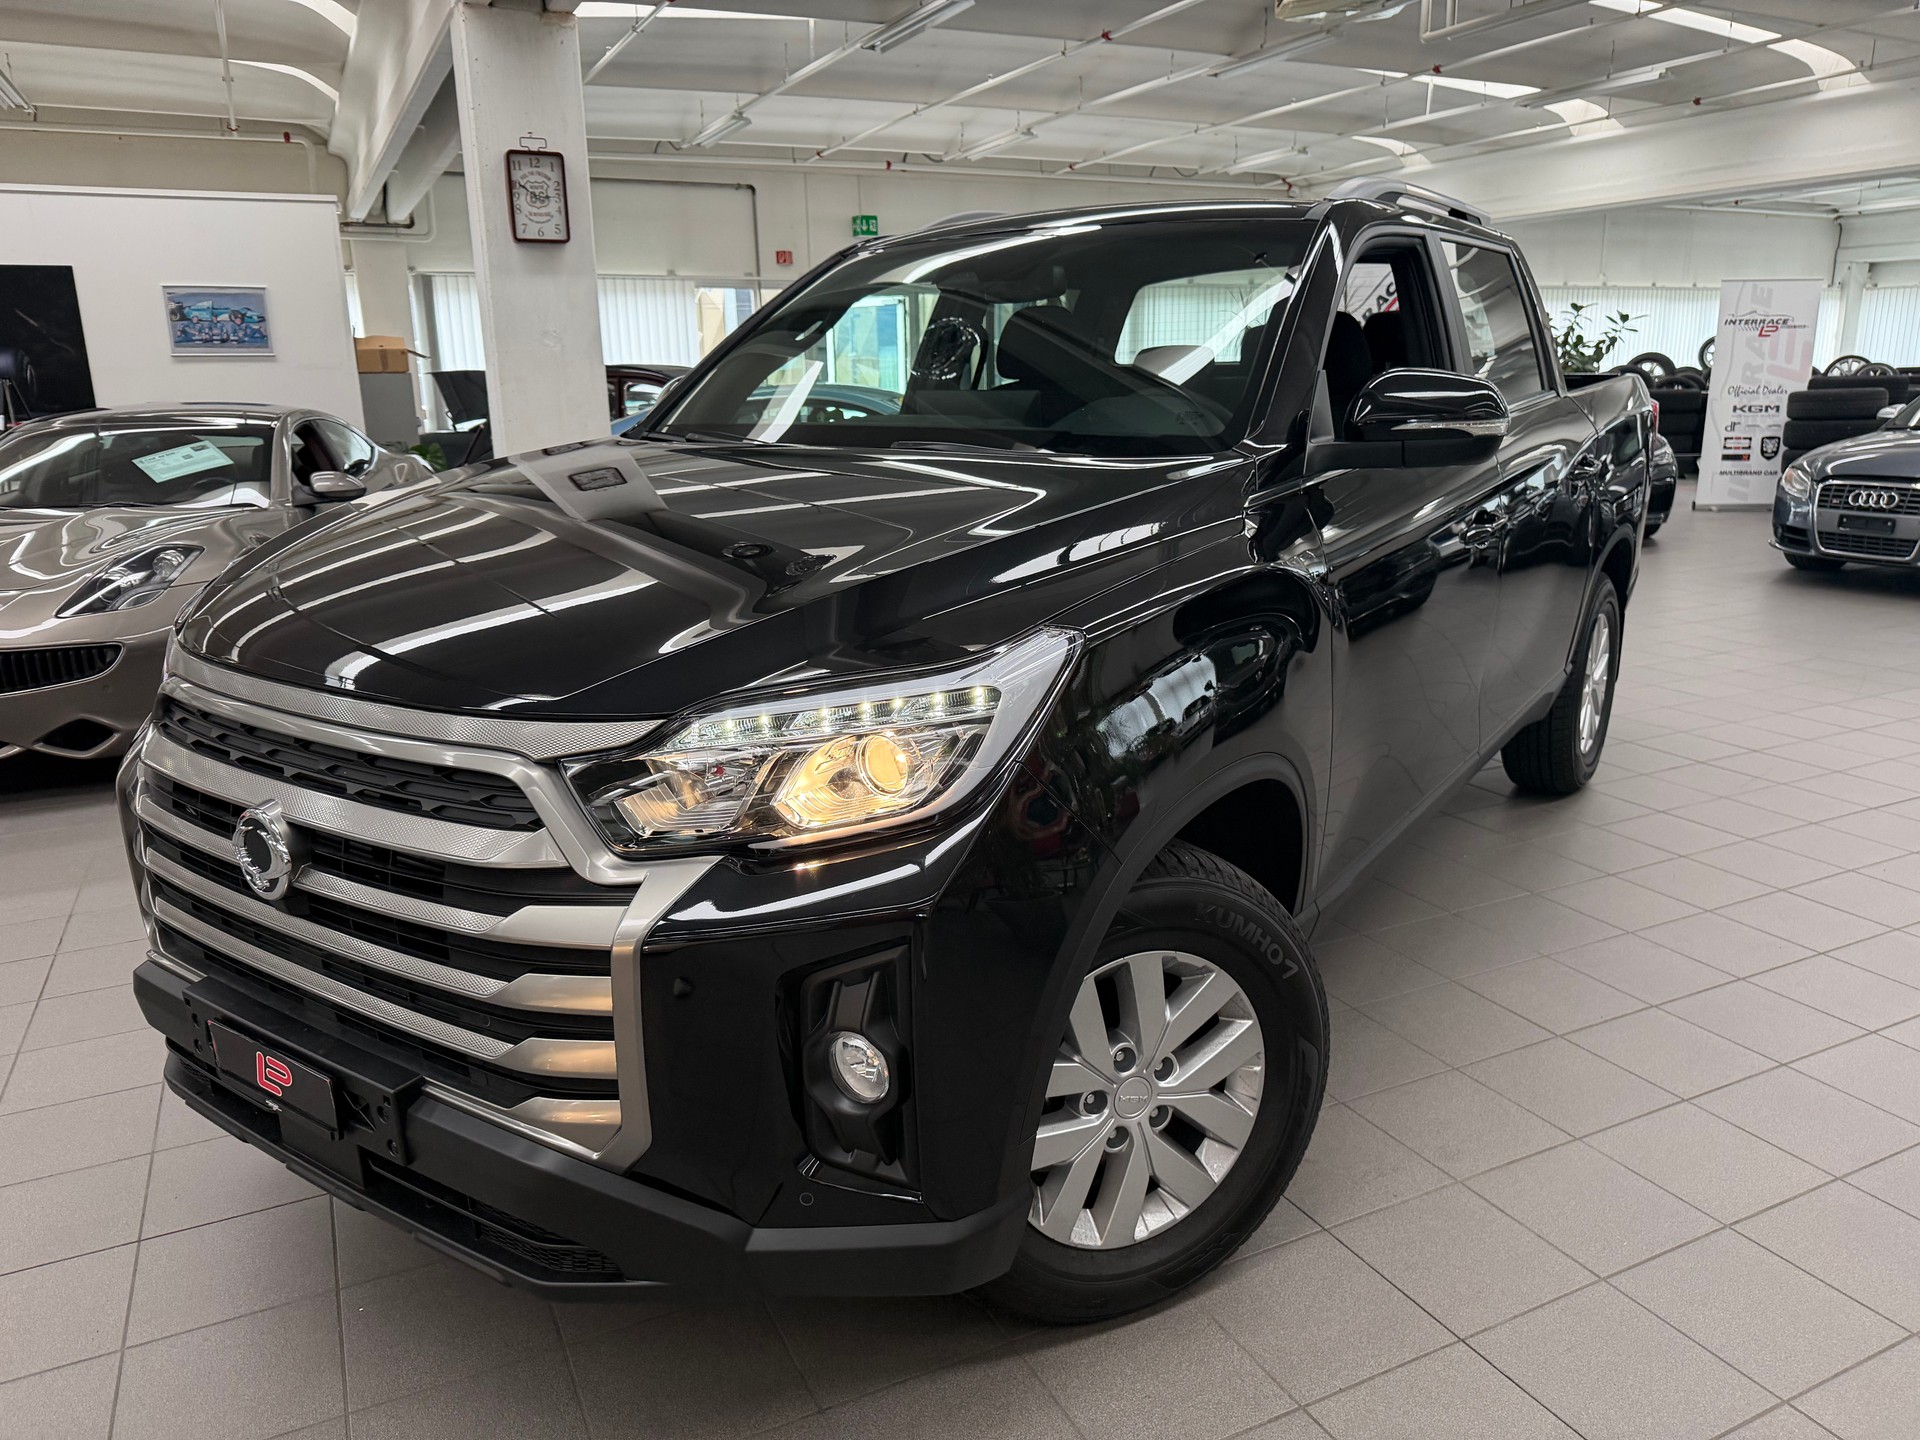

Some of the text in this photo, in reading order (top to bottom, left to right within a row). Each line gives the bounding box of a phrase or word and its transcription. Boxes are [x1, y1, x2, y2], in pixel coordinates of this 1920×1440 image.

[512, 160, 521, 171] 11
[529, 157, 540, 168] 12
[550, 161, 555, 172] 1
[553, 180, 560, 191] 2
[513, 192, 520, 202] 9
[554, 192, 561, 204] 3
[515, 203, 522, 214] 8
[556, 205, 562, 216] 4
[521, 223, 528, 234] 7
[537, 226, 545, 238] 6
[554, 223, 561, 235] 5
[1724, 318, 1790, 327] INTERRACE
[1727, 384, 1788, 398] Official Dealer
[1732, 404, 1780, 413] KGM
